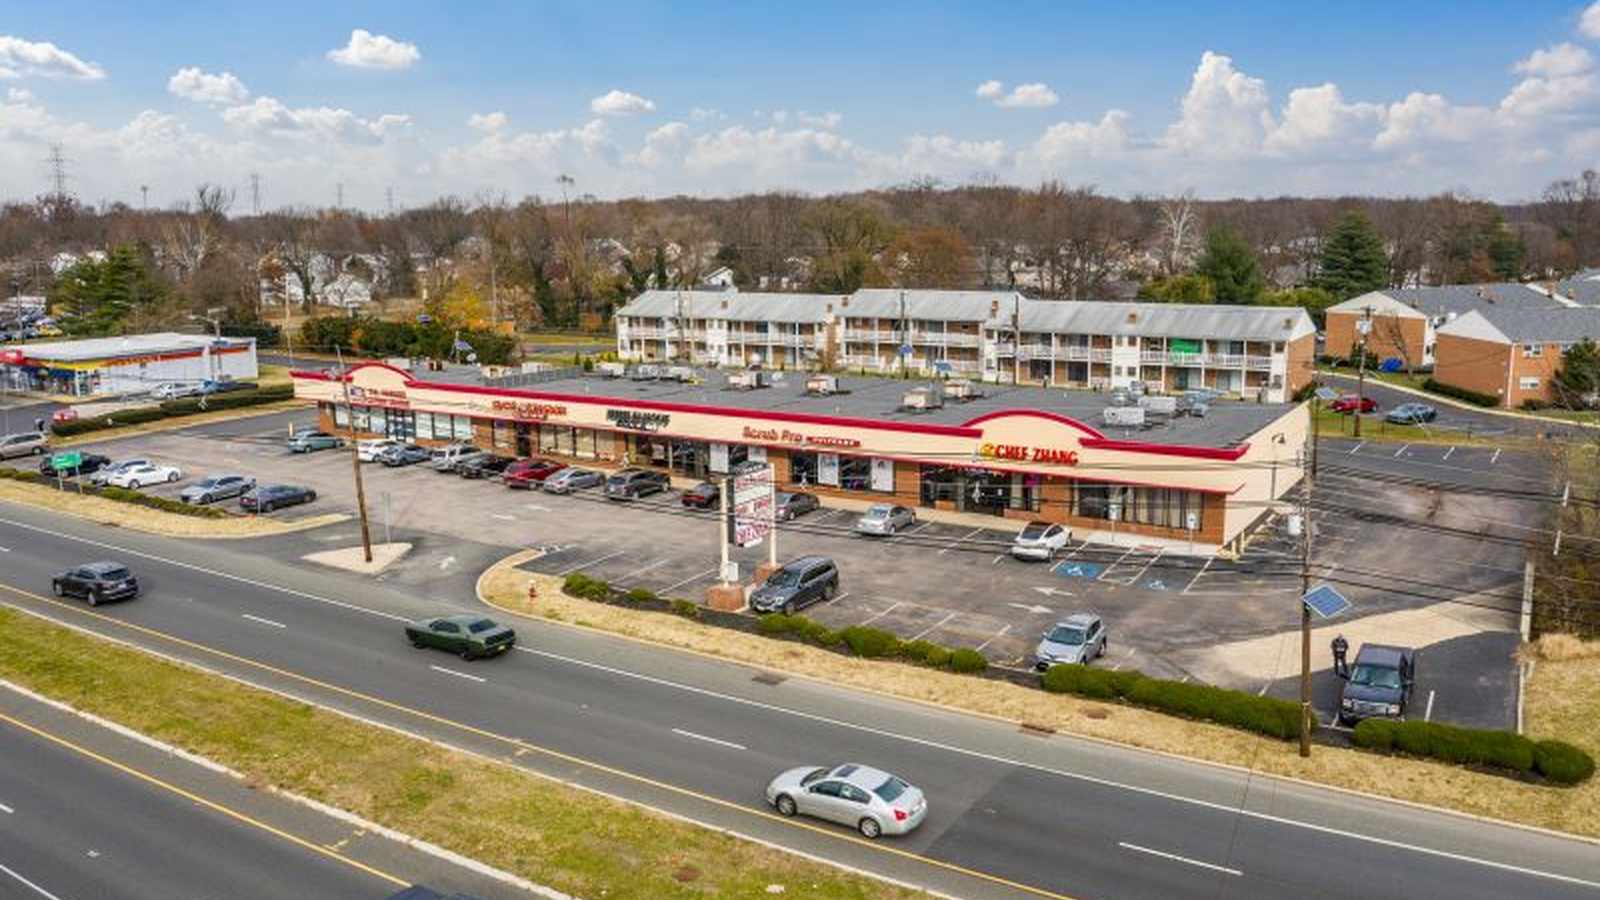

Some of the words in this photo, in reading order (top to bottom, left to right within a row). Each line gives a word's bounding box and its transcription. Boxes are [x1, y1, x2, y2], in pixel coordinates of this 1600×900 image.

[743, 426, 778, 441] Scrub
[782, 429, 803, 442] Pro
[995, 444, 1028, 461] CHEF
[1032, 448, 1079, 466] ZHANG
